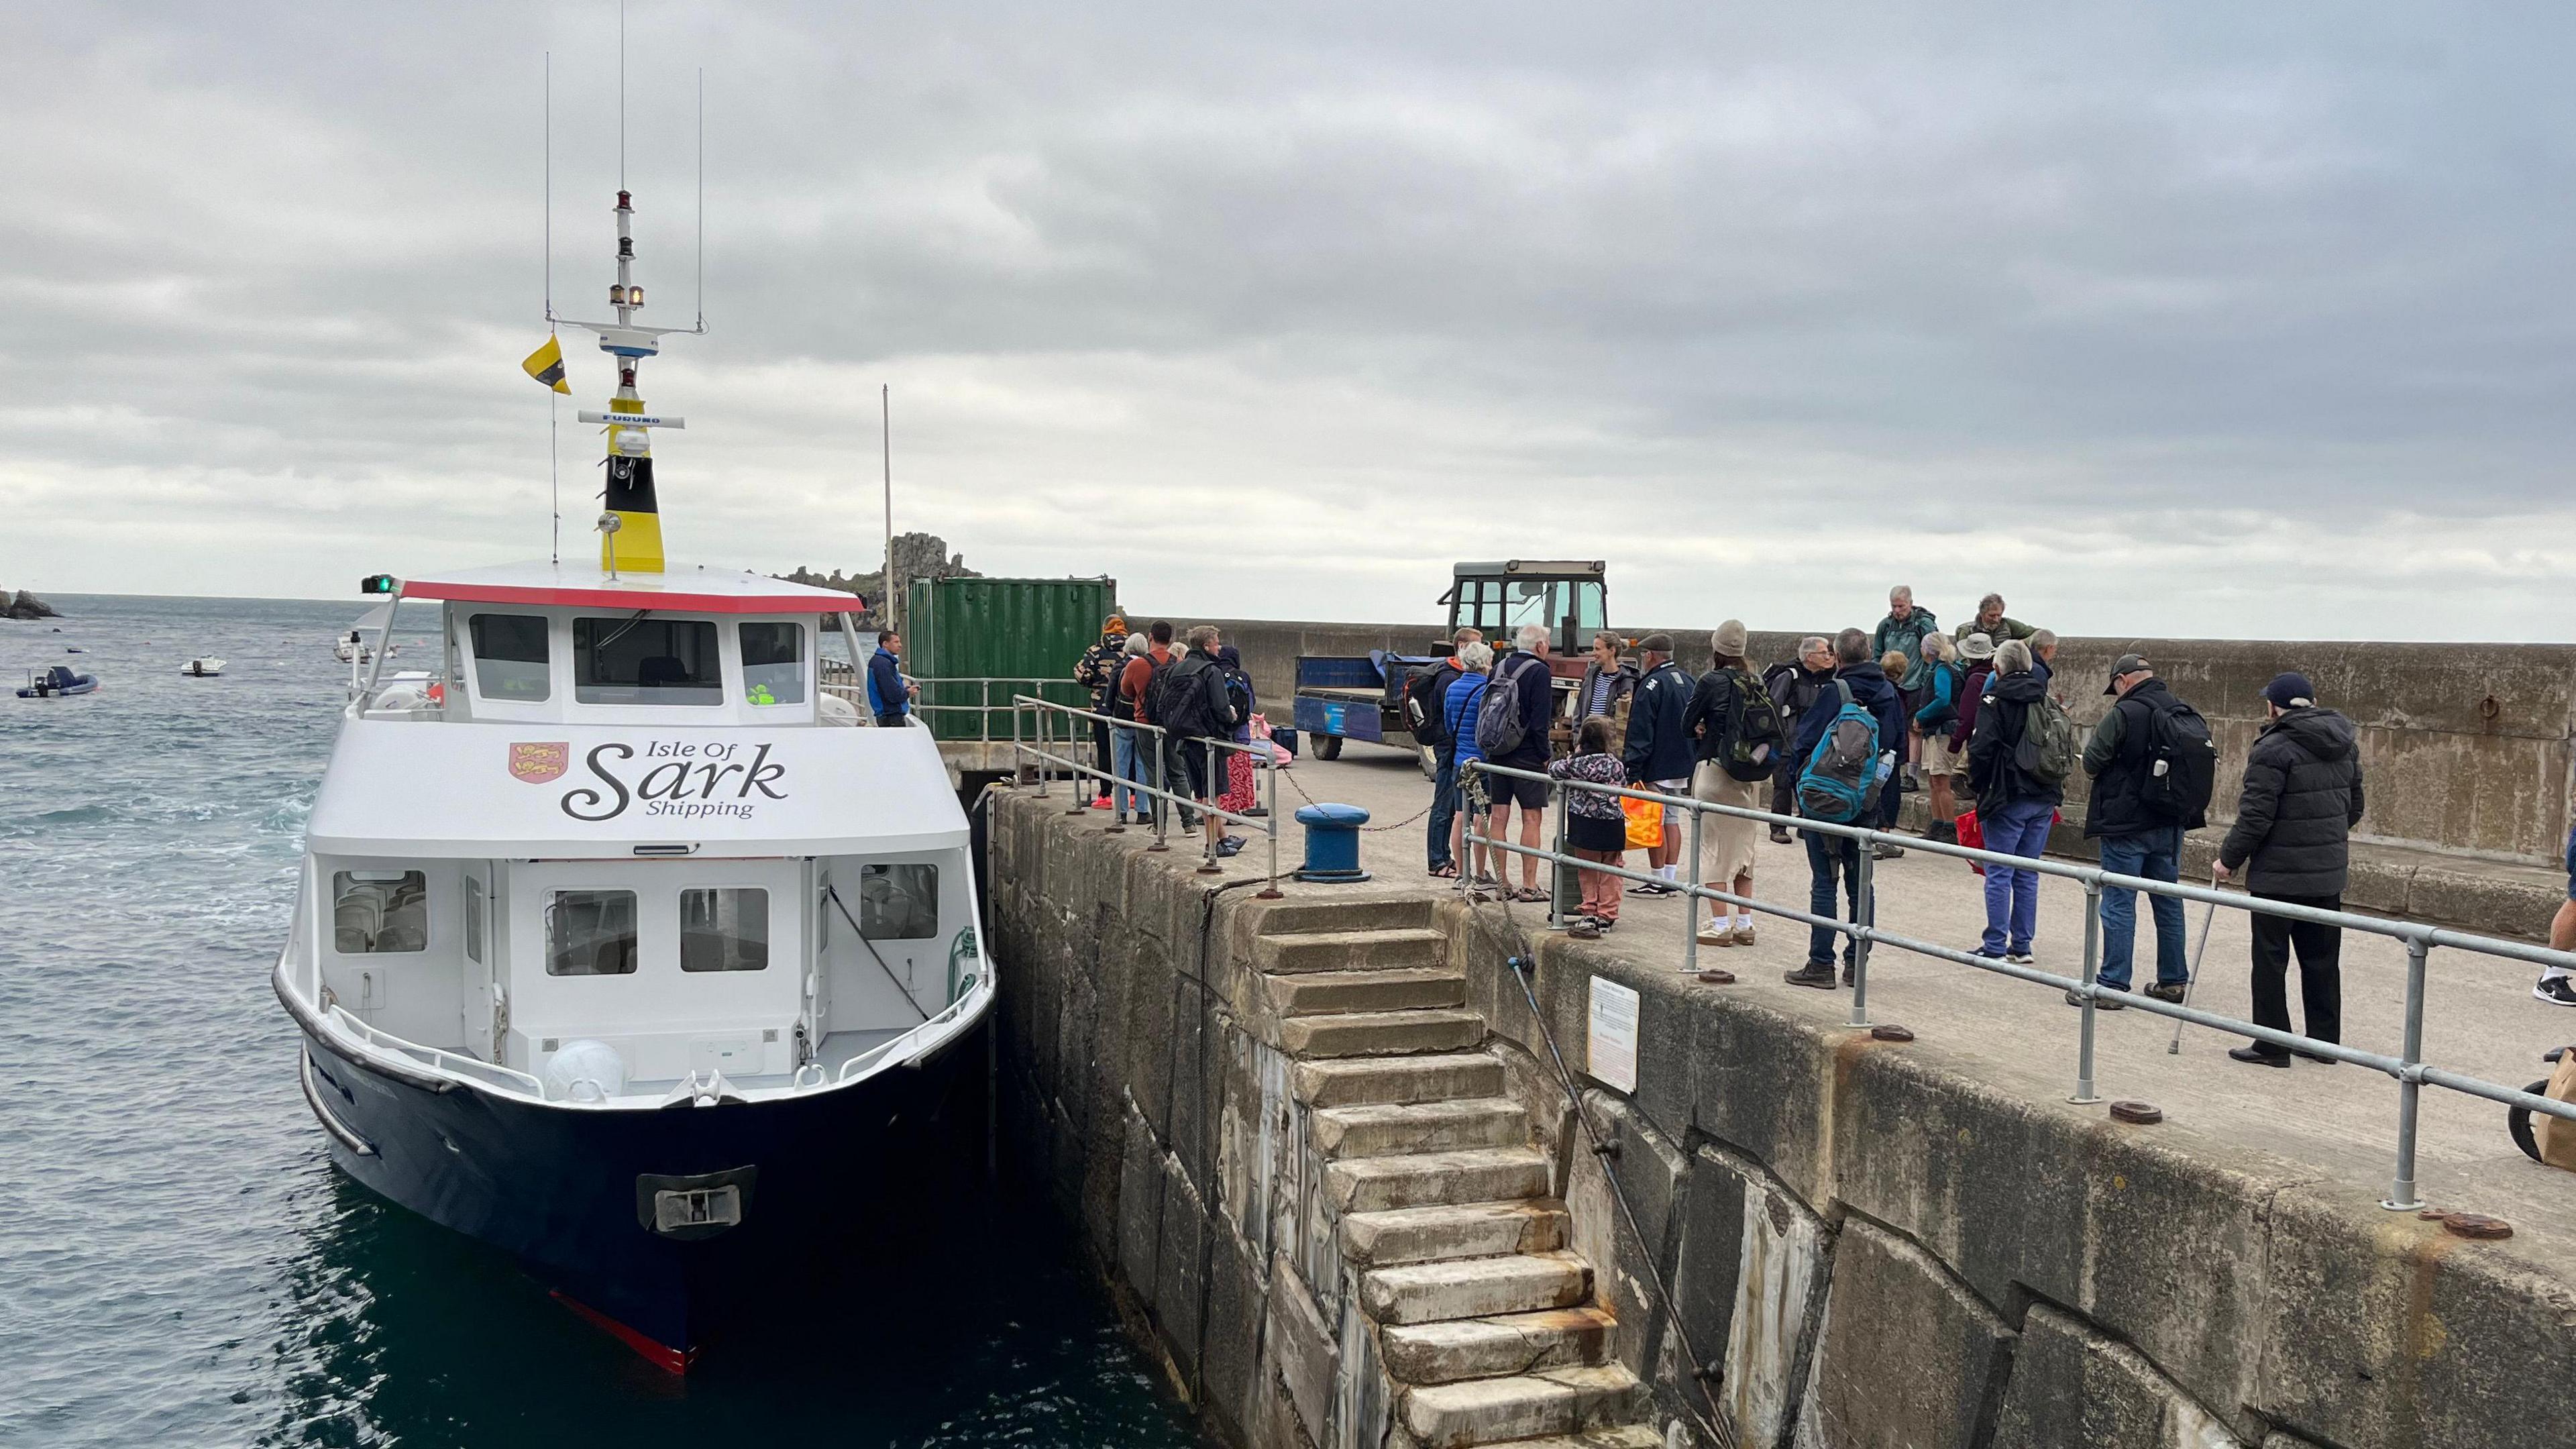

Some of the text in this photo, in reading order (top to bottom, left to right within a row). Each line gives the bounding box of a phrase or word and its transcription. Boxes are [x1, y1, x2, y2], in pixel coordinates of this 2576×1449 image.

[602, 415, 660, 424] FURUNO
[645, 740, 739, 761] Isle Of
[560, 743, 789, 822] Sark
[645, 800, 755, 820] Shipping
